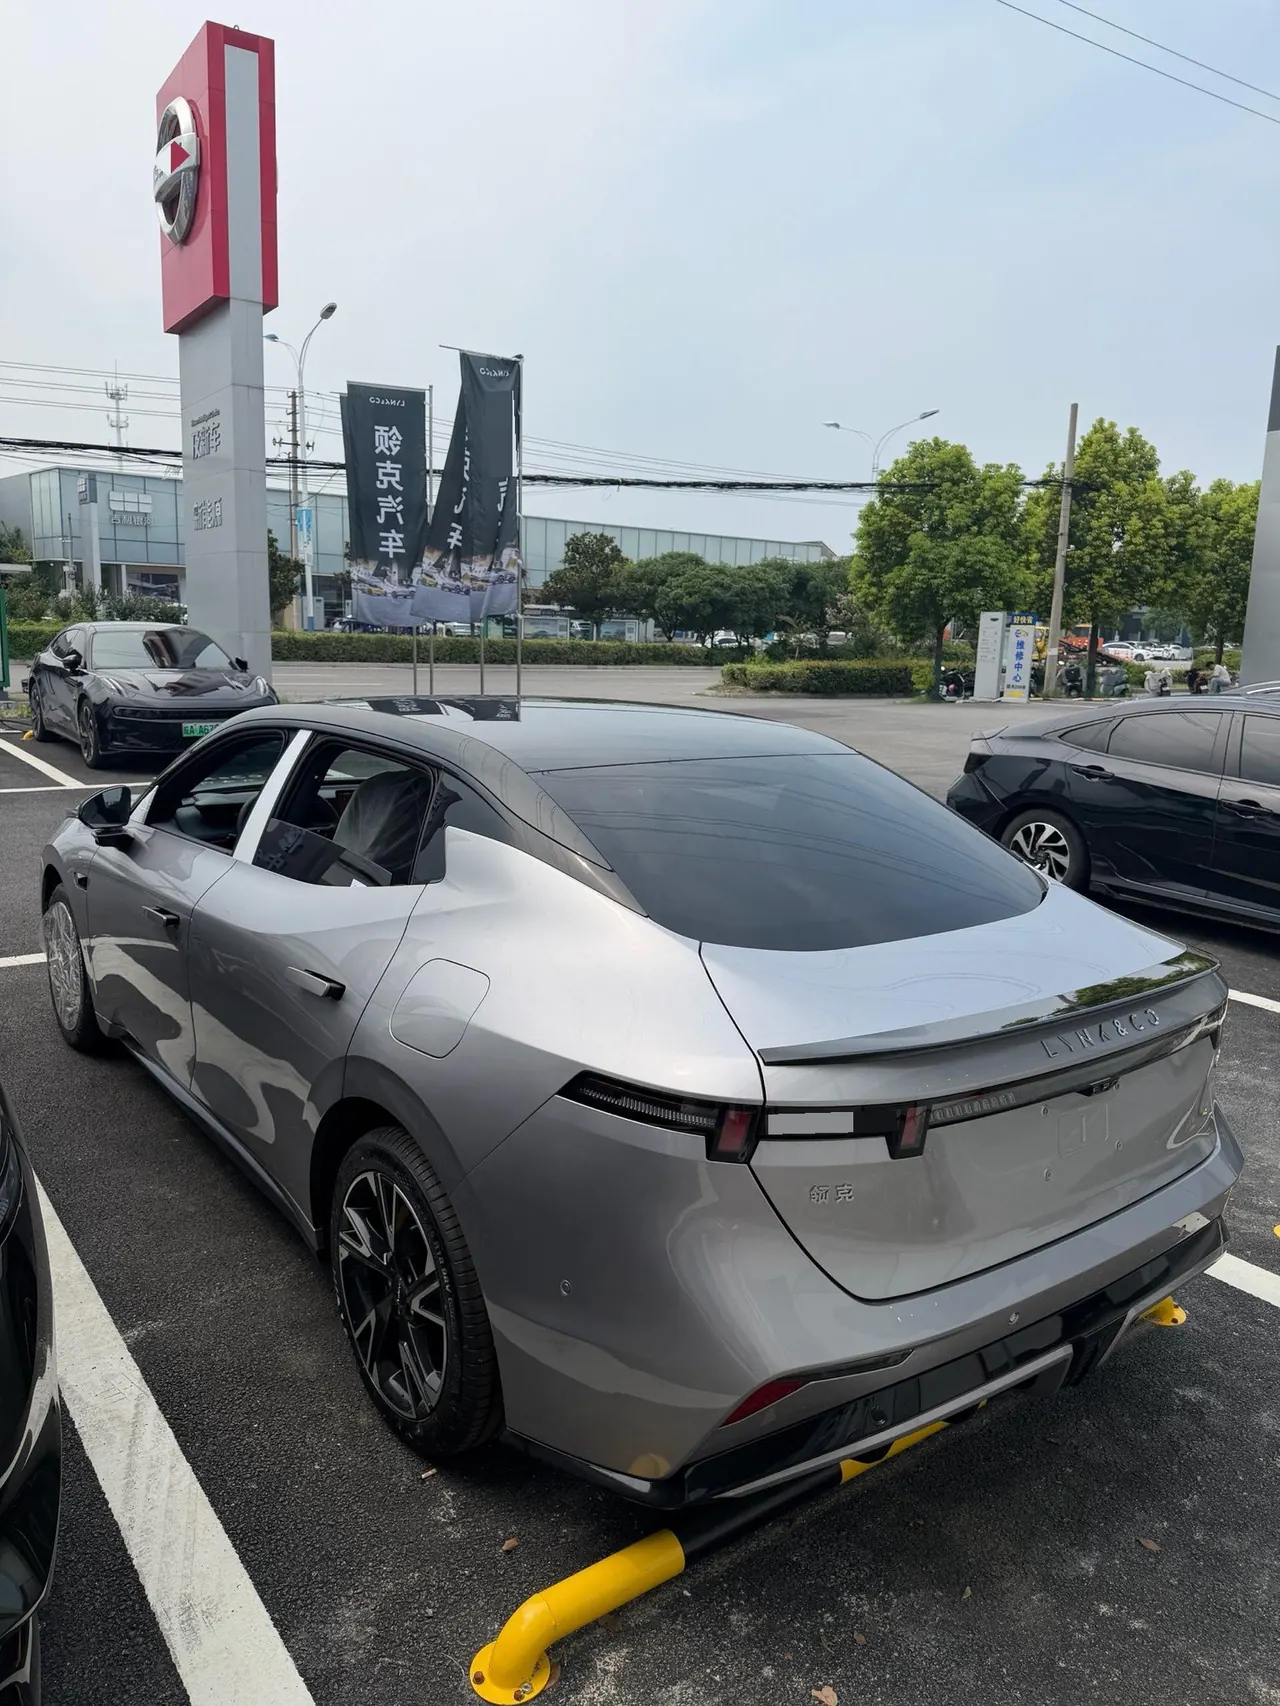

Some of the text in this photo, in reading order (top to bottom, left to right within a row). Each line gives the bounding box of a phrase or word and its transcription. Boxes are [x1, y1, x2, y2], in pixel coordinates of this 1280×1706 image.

[1012, 640, 1025, 683] 维修中心
[1040, 1008, 1160, 1059] LYNK&CO
[809, 1183, 854, 1205] 领克
